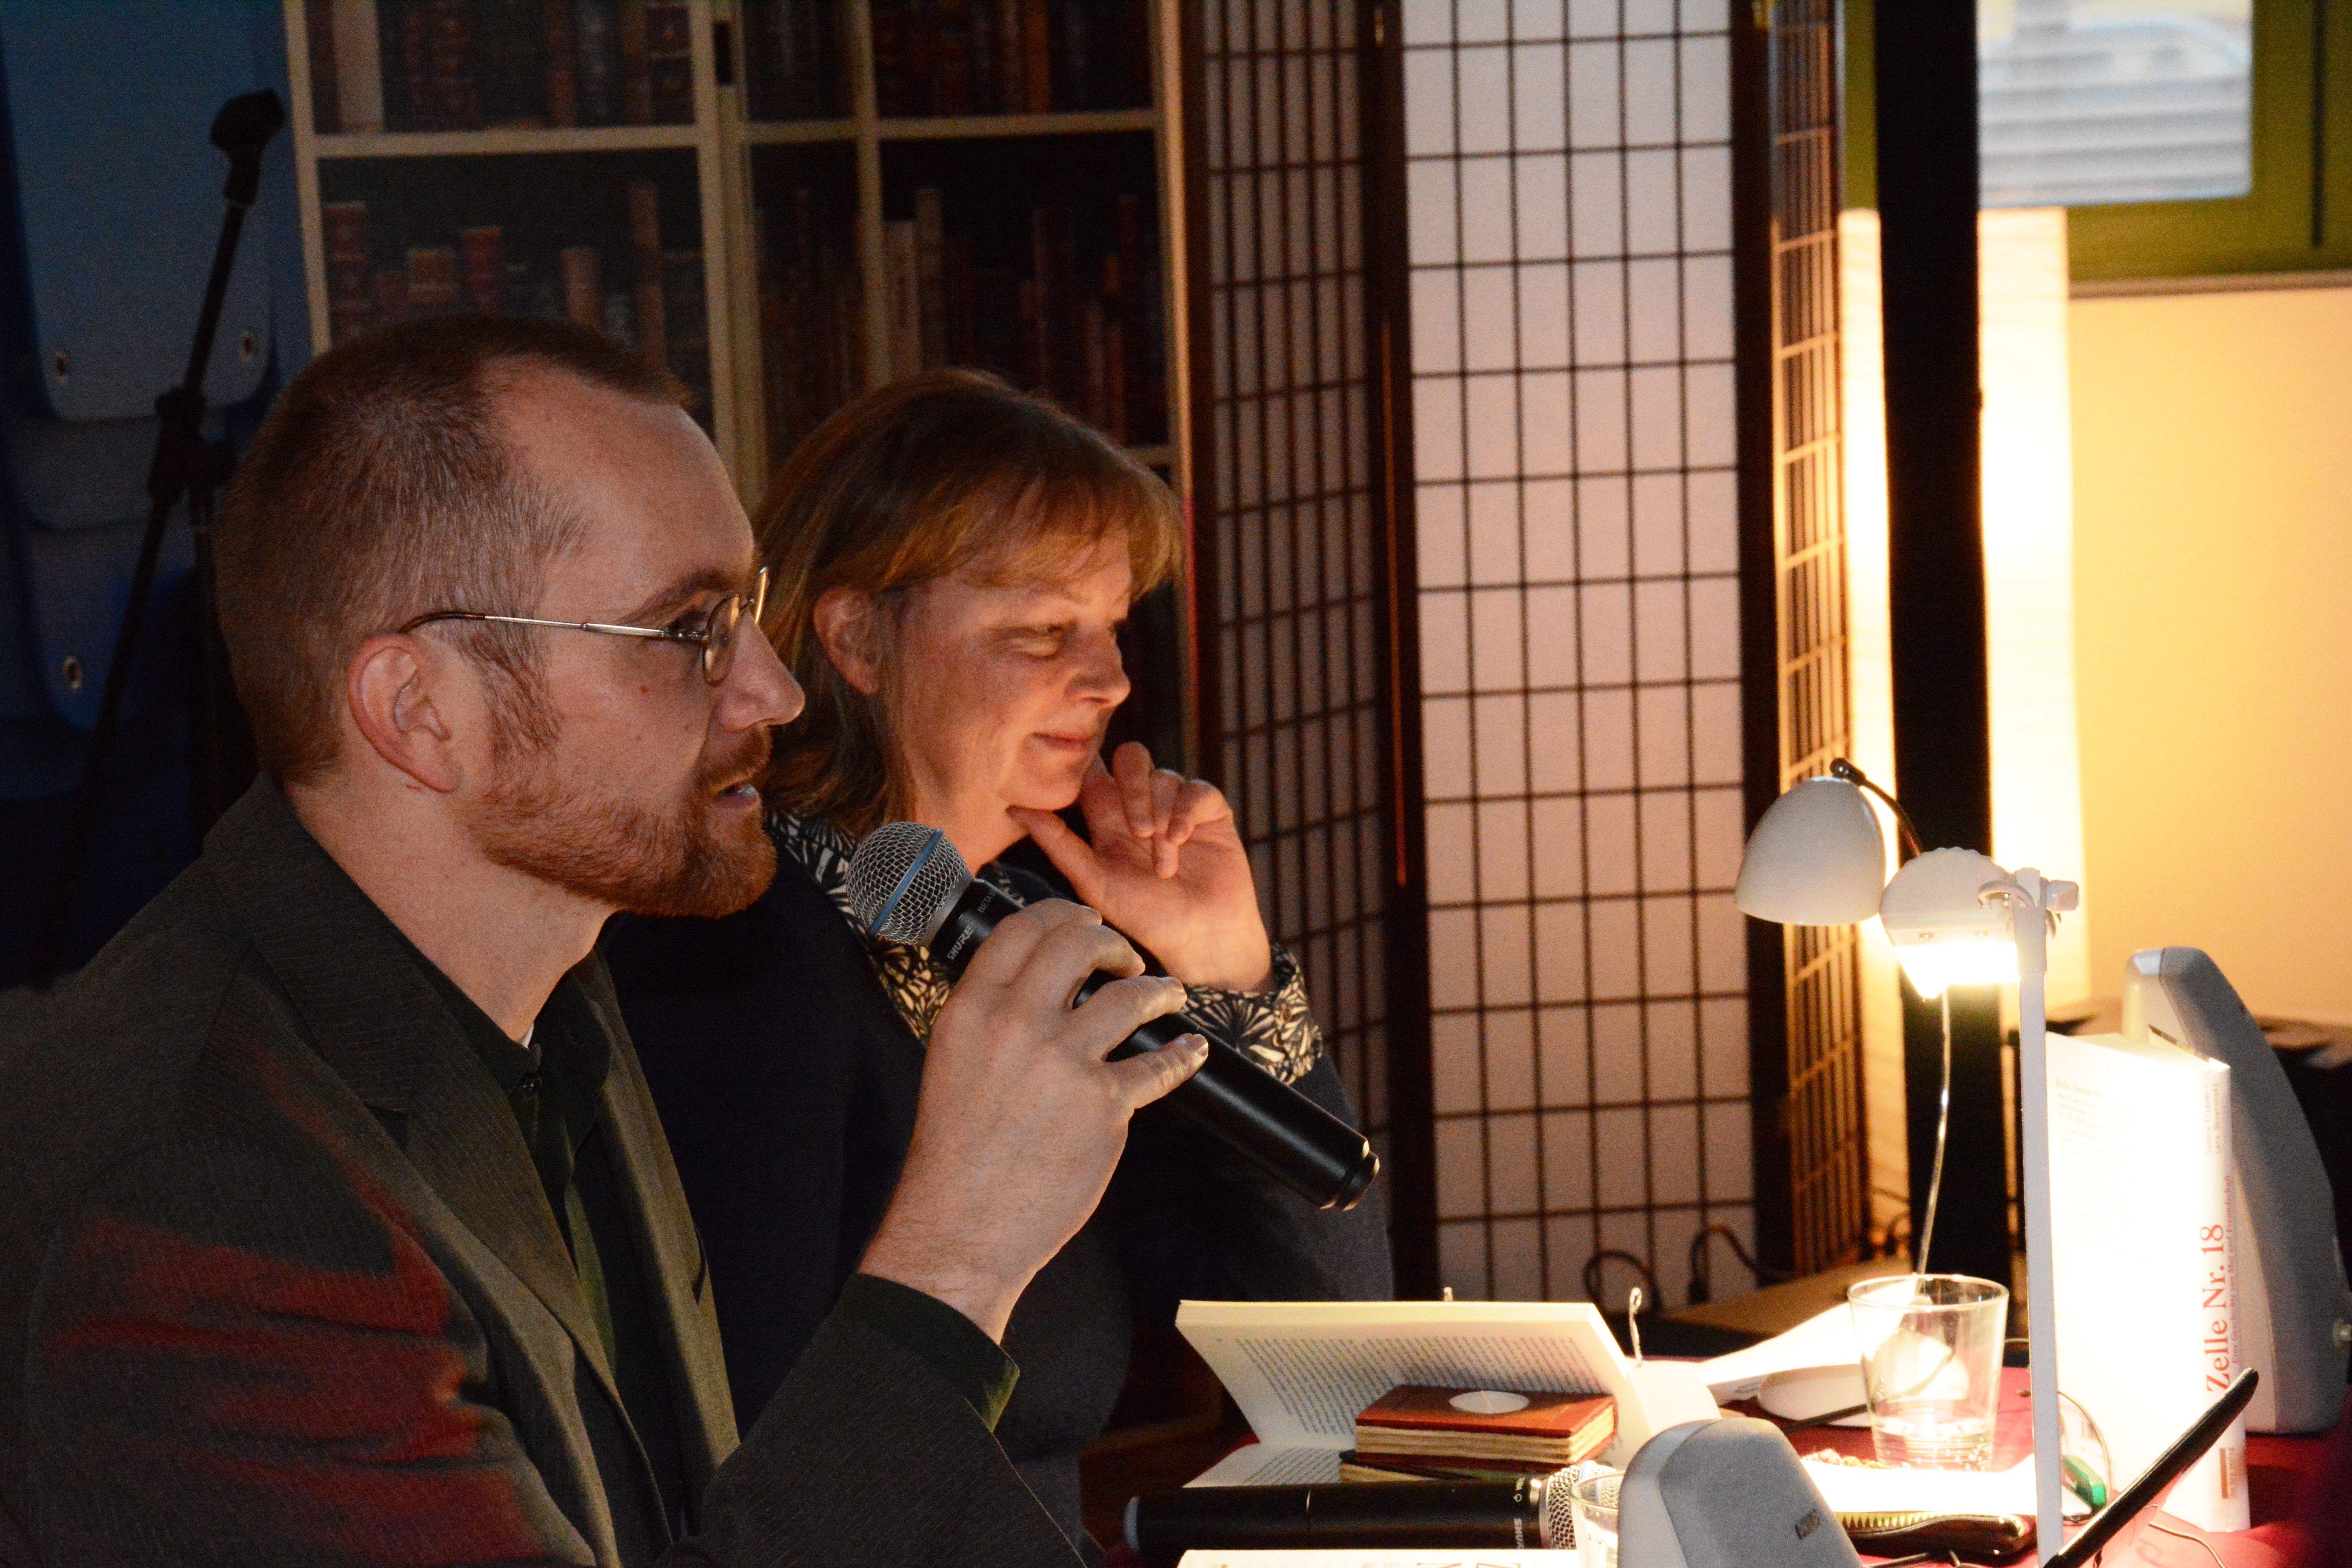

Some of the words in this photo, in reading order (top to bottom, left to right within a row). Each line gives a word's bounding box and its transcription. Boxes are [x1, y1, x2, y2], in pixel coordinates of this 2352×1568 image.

[947, 925, 974, 961] SHURE
[2223, 1175, 2232, 1233] Freundschaft
[2199, 1224, 2225, 1255] 18
[2201, 1265, 2226, 1309] Nr.
[2203, 1319, 2230, 1392] Zelle
